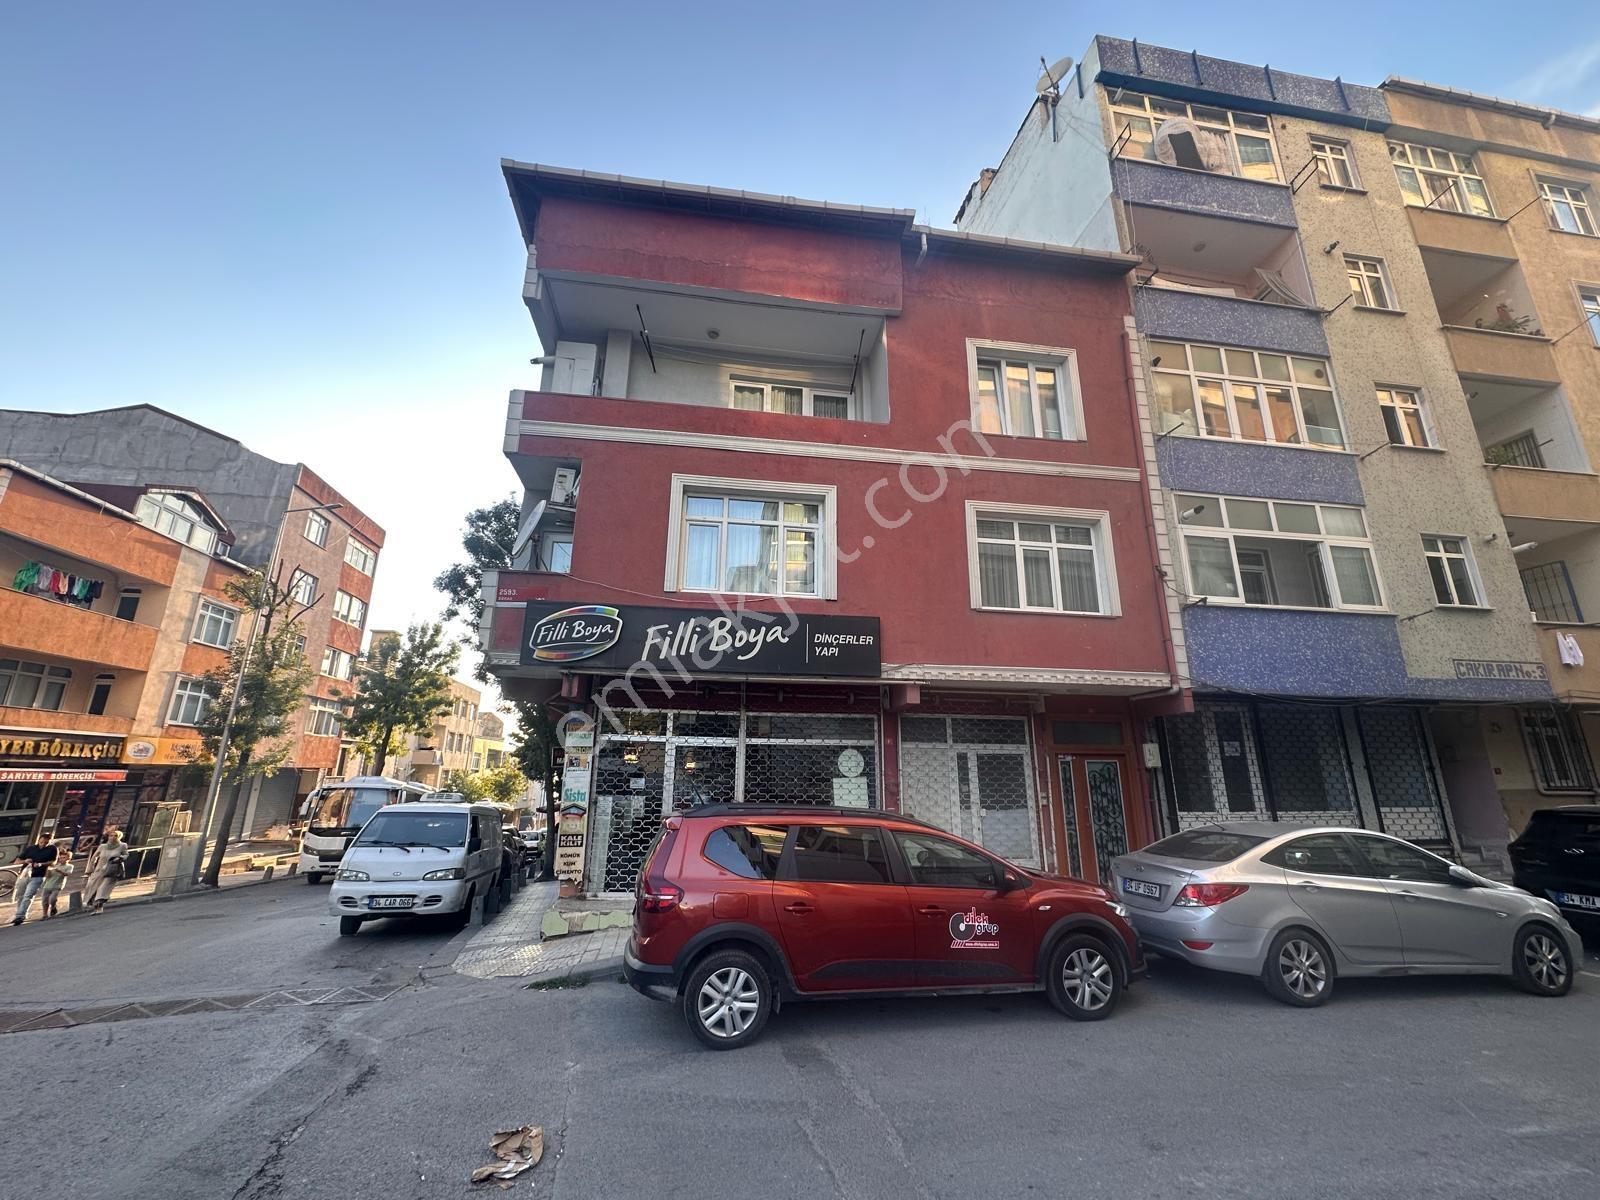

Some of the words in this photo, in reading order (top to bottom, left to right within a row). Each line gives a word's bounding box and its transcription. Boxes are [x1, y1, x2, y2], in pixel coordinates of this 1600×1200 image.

[536, 621, 570, 643] Filli
[571, 620, 614, 642] Boya
[640, 618, 702, 662] Filli
[708, 616, 790, 661] Boya
[814, 632, 874, 646] DİNÇERLER
[815, 646, 839, 657] YAPI
[37, 737, 123, 760] BÖREKÇİSİ
[0, 772, 45, 780] SARIYER
[564, 788, 586, 802] Sista
[964, 907, 988, 924] dilek
[976, 924, 998, 935] grup
